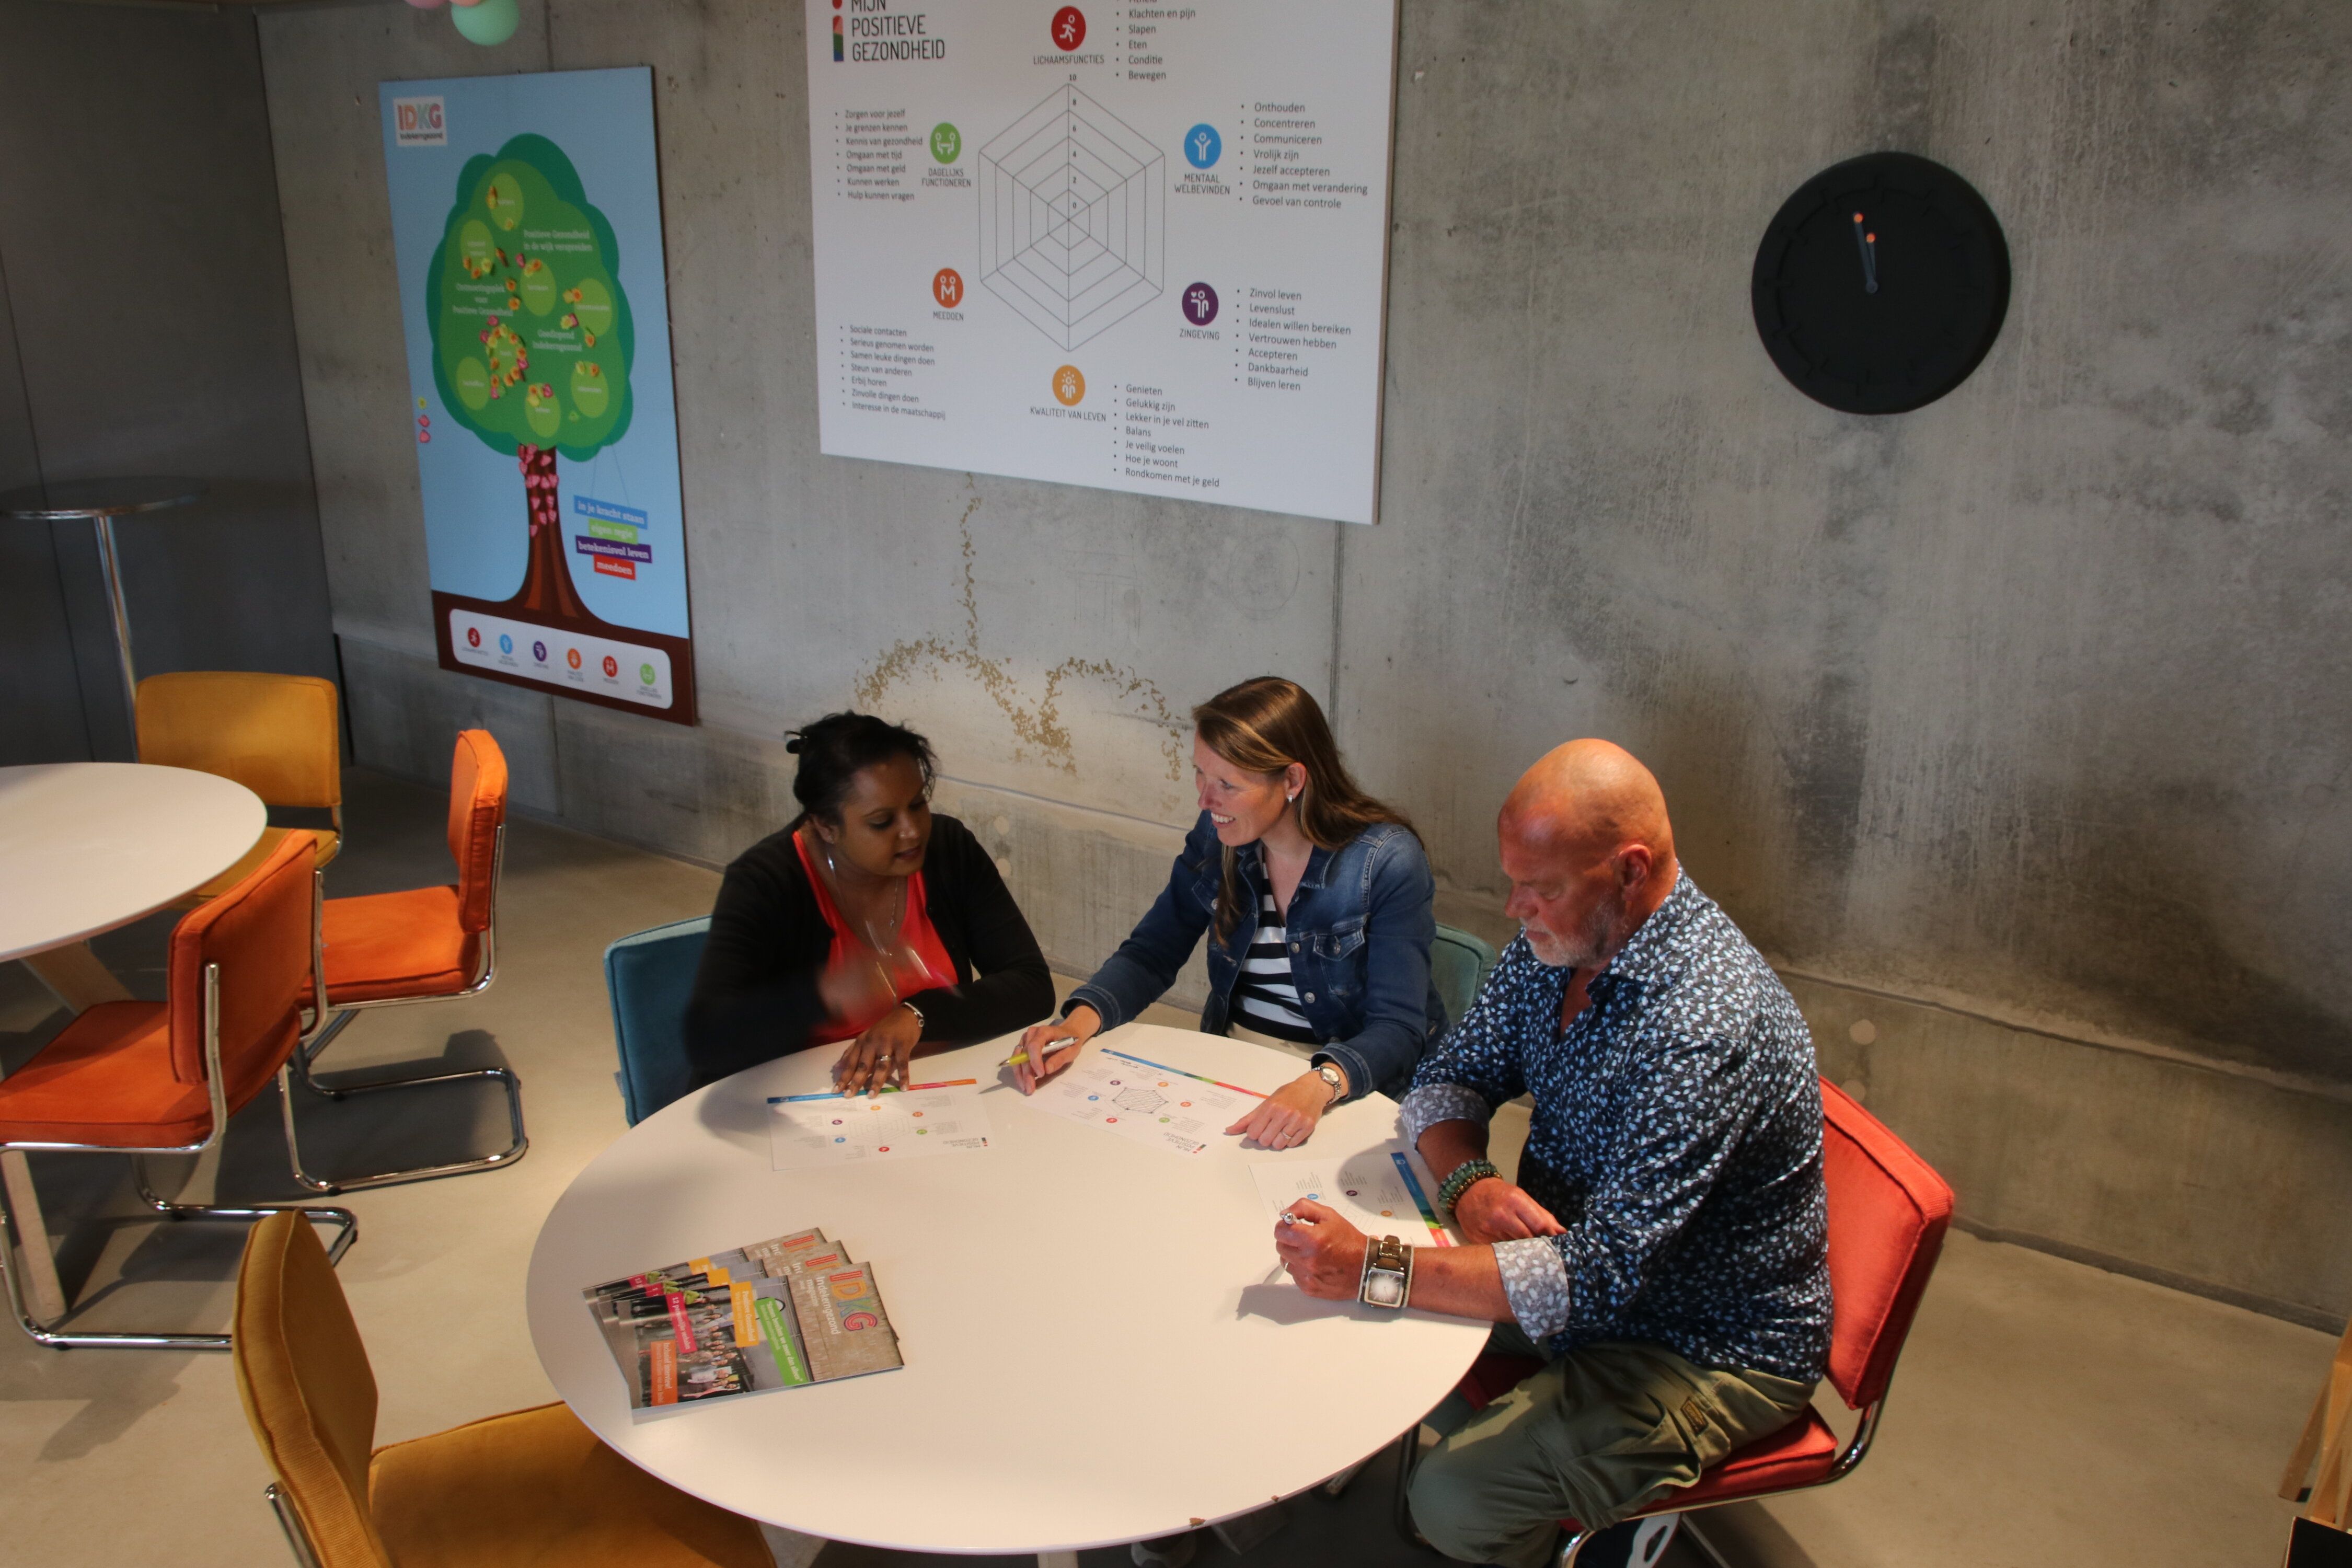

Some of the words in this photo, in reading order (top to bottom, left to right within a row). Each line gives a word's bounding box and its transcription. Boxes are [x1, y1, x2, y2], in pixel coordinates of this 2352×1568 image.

[851, 0, 886, 13] MIJN
[1129, 9, 1165, 18] Klachten
[1180, 8, 1195, 20] pijn
[852, 14, 926, 37] POSITIEVE
[1129, 24, 1156, 36] Slapen
[852, 39, 945, 62] GEZONDHEID
[1129, 40, 1147, 49] Eten
[1033, 54, 1104, 65] LICHAAMSFUNCTIES
[1128, 55, 1162, 64] Conditie
[1128, 70, 1166, 82] Bewegen
[1254, 102, 1305, 112] Onthouden
[398, 103, 442, 130] IDKG
[845, 110, 868, 120] Zorgen
[887, 109, 905, 119] jezelf
[854, 125, 880, 134] grenzen
[1254, 118, 1315, 129] Concentreren
[883, 137, 923, 147] gezondheid
[1254, 133, 1322, 145] Communiceren
[846, 151, 873, 161] Omgaan
[891, 151, 902, 160] tijd
[1253, 149, 1281, 162] Vrolijk
[1284, 150, 1299, 162] zijn
[847, 164, 874, 174] Omgaan
[891, 164, 906, 175] geld
[928, 168, 964, 177] DAGELIJKS
[1253, 165, 1277, 174] Jezelf
[1280, 167, 1330, 177] accepteren
[921, 178, 971, 188] FUNCTIONEREN
[1184, 174, 1219, 183] MENTAAL
[1174, 184, 1230, 195] WELBEVINDEN
[1253, 180, 1289, 192] Omgaan
[1293, 183, 1310, 191] met
[1312, 183, 1368, 196] verandering
[848, 191, 863, 200] Hulp
[864, 191, 890, 200] kunnen
[891, 193, 914, 202] vragen
[1252, 195, 1283, 206] Gevoel
[1304, 199, 1341, 209] controle
[1250, 287, 1275, 298] Zinvol
[1278, 290, 1301, 300] leven
[1250, 303, 1295, 315] Levenslust
[933, 311, 964, 321] MEEDOEN
[850, 325, 872, 334] Sociale
[874, 328, 907, 337] contacten
[1250, 318, 1281, 329] Idealen
[1284, 321, 1309, 331] willen
[1312, 322, 1351, 335] bereiken
[1180, 328, 1219, 340] ZINGEVING
[850, 338, 873, 347] Serieus
[908, 343, 934, 352] worden
[1249, 333, 1300, 345] Vertrouwen
[1303, 337, 1336, 349] hebben
[851, 351, 872, 359] Samen
[894, 355, 916, 365] dingen
[918, 356, 935, 365] doen
[1248, 348, 1297, 360] Accepteren
[851, 363, 869, 372] Steun
[885, 367, 912, 376] anderen
[1248, 362, 1308, 377] Dankbaarheid
[851, 376, 866, 386] Erbij
[1248, 377, 1276, 389] Blijven
[1278, 379, 1300, 390] leren
[852, 388, 877, 398] Zinvolle
[879, 391, 900, 402] dingen
[902, 394, 919, 402] doen
[1126, 384, 1162, 395] Genieten
[852, 402, 881, 412] Interesse
[891, 406, 899, 414] de
[901, 408, 946, 420] maatschappij
[1126, 398, 1160, 411] Gelukkig
[1162, 402, 1175, 412] zijn
[1030, 407, 1065, 417] KWALITEIT
[1068, 411, 1081, 419] VAN
[1083, 412, 1106, 422] LEVEN
[1126, 412, 1151, 422] Lekker
[1163, 416, 1170, 426] je
[1172, 418, 1184, 426] vel
[1186, 419, 1209, 429] zitten
[1126, 426, 1151, 437] Balans
[1126, 440, 1133, 449] Je
[1136, 442, 1156, 453] veilig
[1158, 445, 1184, 454] voelen
[1126, 454, 1141, 464] Hoe
[1143, 456, 1150, 466] je
[1152, 459, 1178, 468] woont
[1126, 467, 1172, 481] Rondkomen
[1175, 475, 1191, 483] met
[1192, 476, 1200, 486] je
[1202, 478, 1219, 488] geld
[596, 505, 620, 518] kracht
[622, 513, 644, 524] staan
[578, 541, 626, 556] betekenisvol
[627, 547, 649, 559] leven
[816, 1276, 841, 1334] Indekerngezond
[829, 1270, 878, 1332] IDKG
